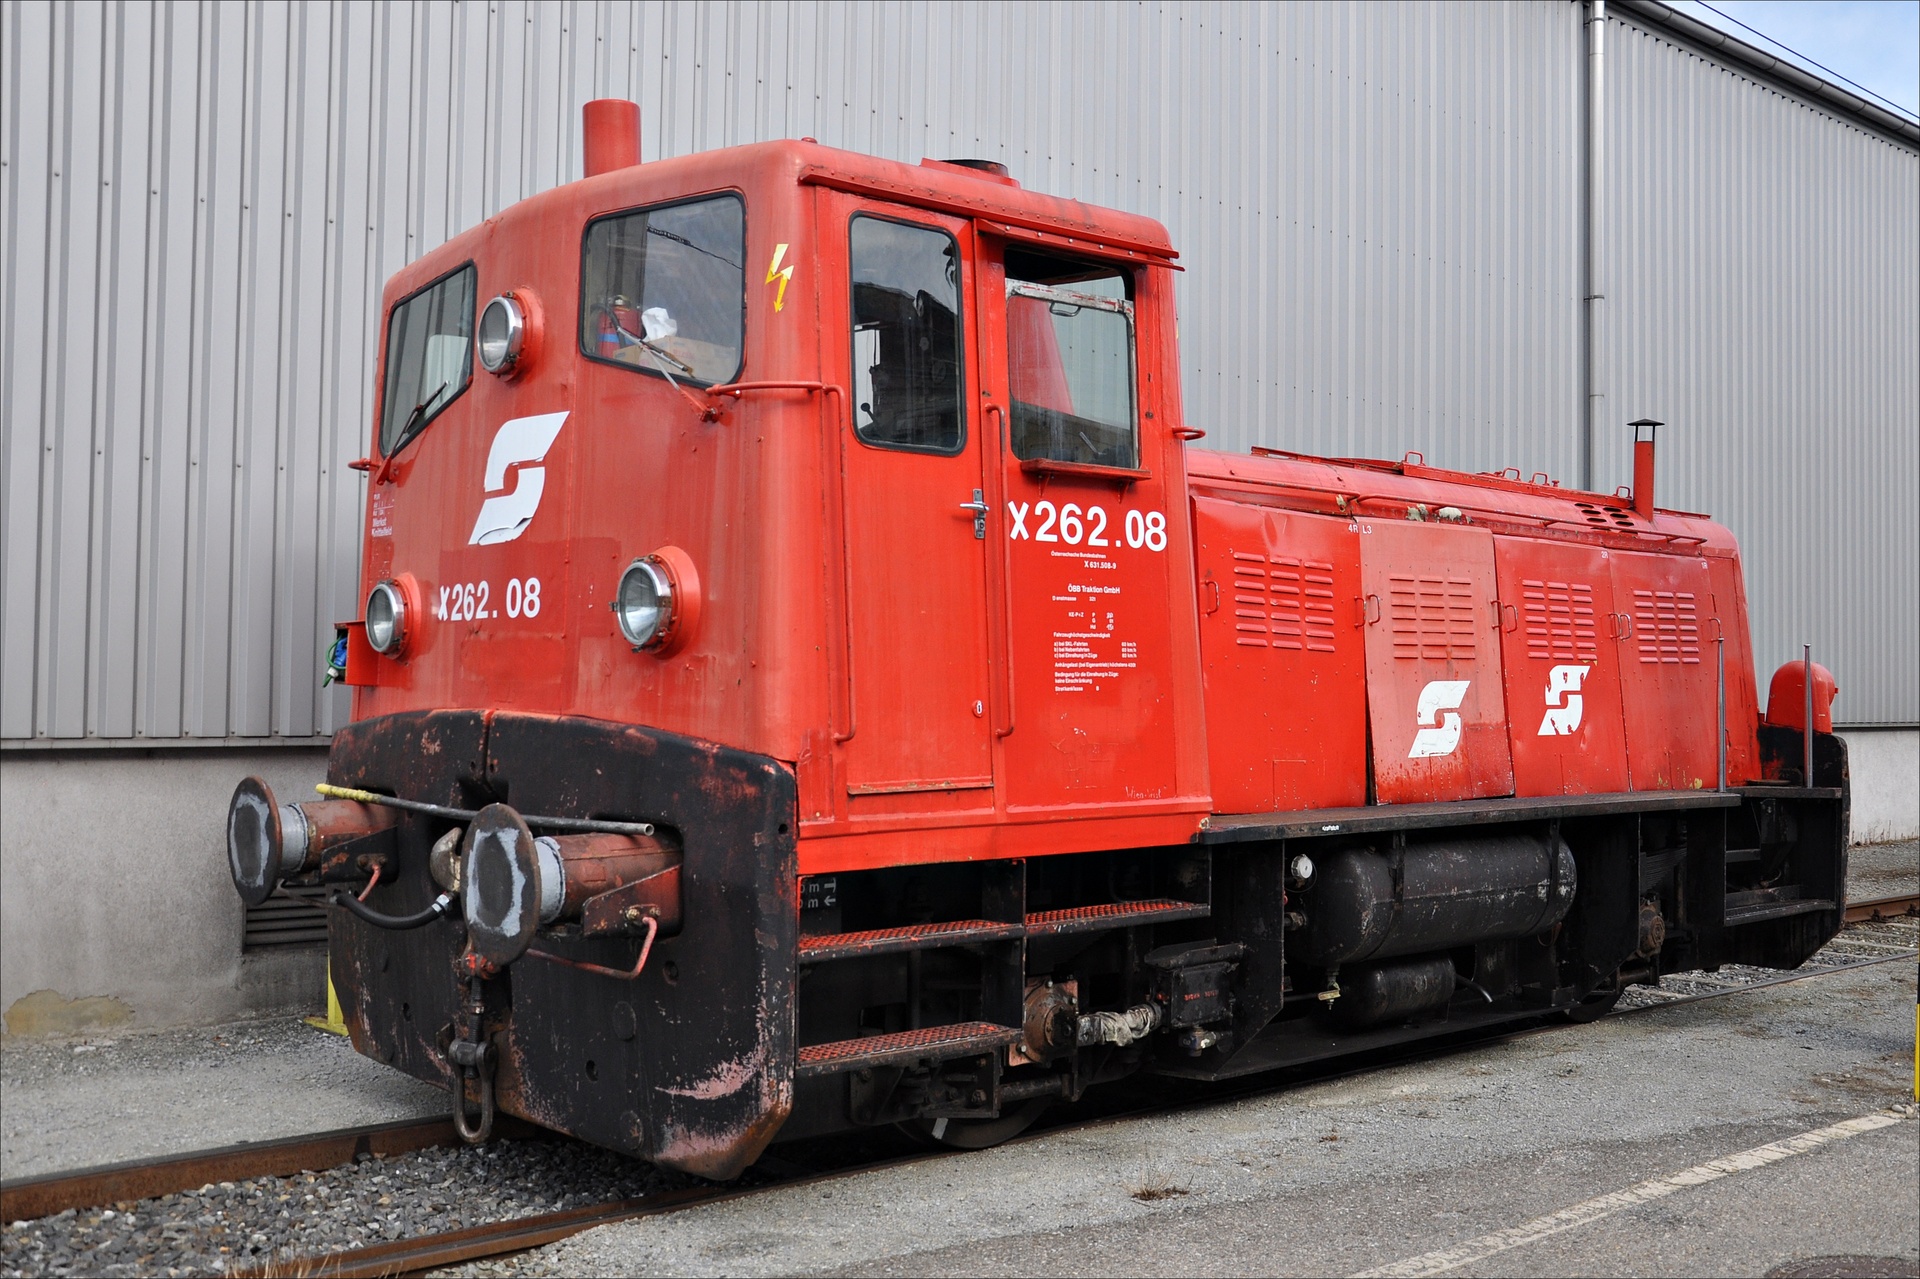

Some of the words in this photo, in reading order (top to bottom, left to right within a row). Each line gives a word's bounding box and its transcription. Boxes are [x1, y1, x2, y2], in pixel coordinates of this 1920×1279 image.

[1007, 500, 1168, 552] X262.08
[1348, 524, 1359, 533] 4R
[1362, 525, 1372, 534] L3
[1068, 584, 1081, 592] ÖBB
